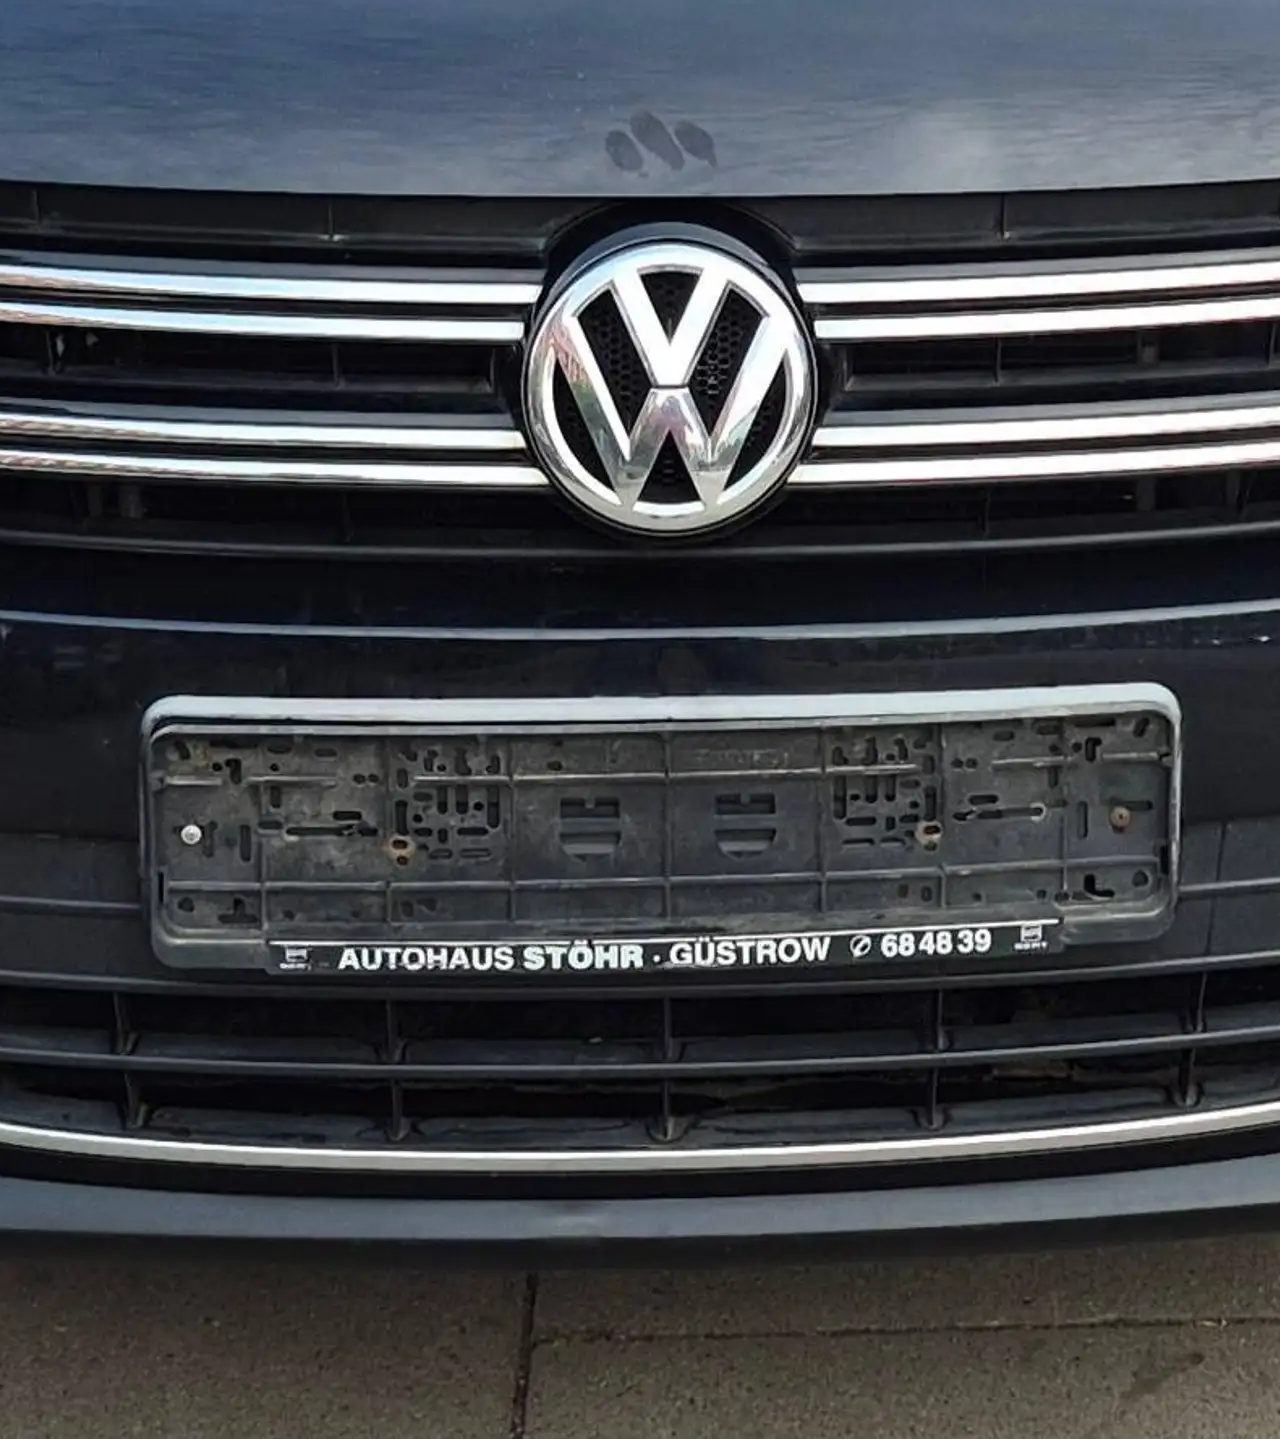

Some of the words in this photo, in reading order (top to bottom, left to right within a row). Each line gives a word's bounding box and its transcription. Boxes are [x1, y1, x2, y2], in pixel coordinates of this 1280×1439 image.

[544, 252, 794, 516] VW
[337, 946, 515, 971] AUTOHAUS
[522, 939, 645, 970] STÖHR
[668, 936, 831, 966] GÜSTROW
